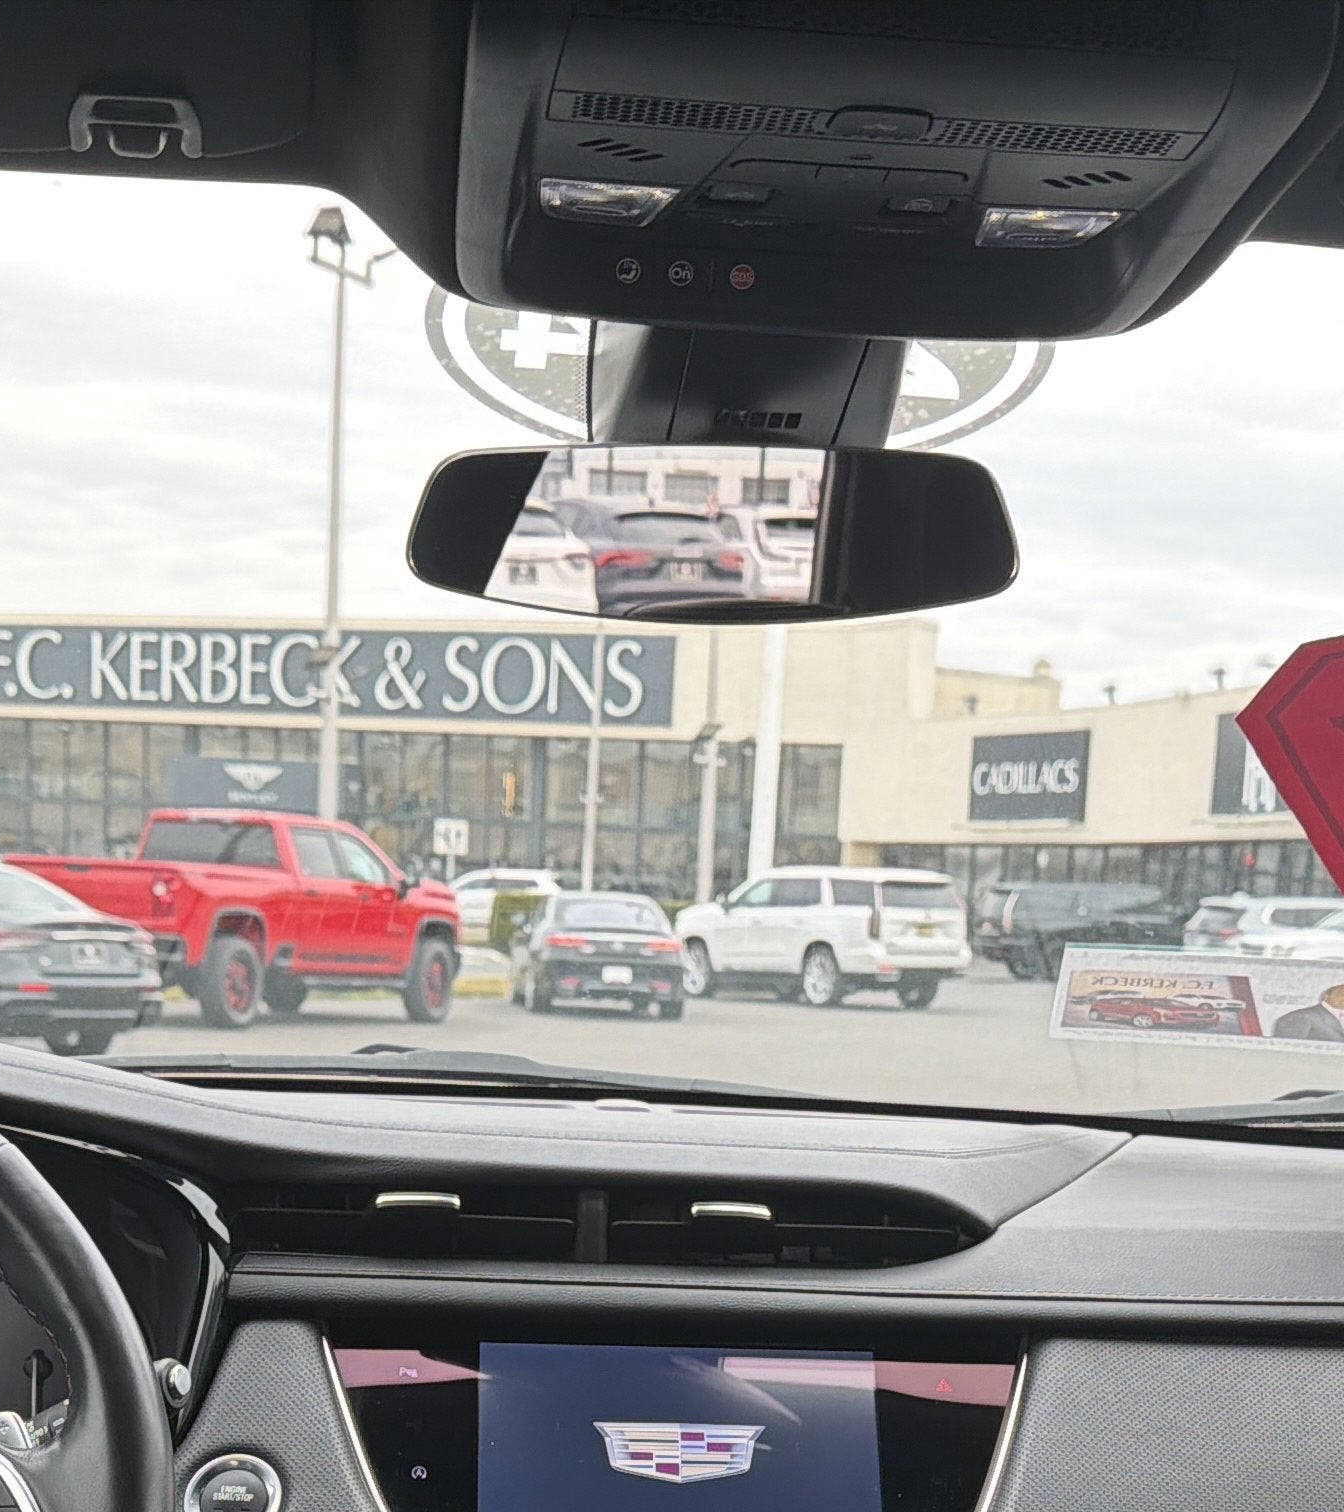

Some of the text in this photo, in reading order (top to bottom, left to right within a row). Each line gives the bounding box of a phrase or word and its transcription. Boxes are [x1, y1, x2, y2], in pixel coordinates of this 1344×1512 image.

[88, 631, 362, 709] KERBECK
[373, 636, 427, 712] &
[442, 635, 644, 718] SONS
[220, 1485, 247, 1494] ENGINE
[212, 1492, 254, 1502] START/STOP
